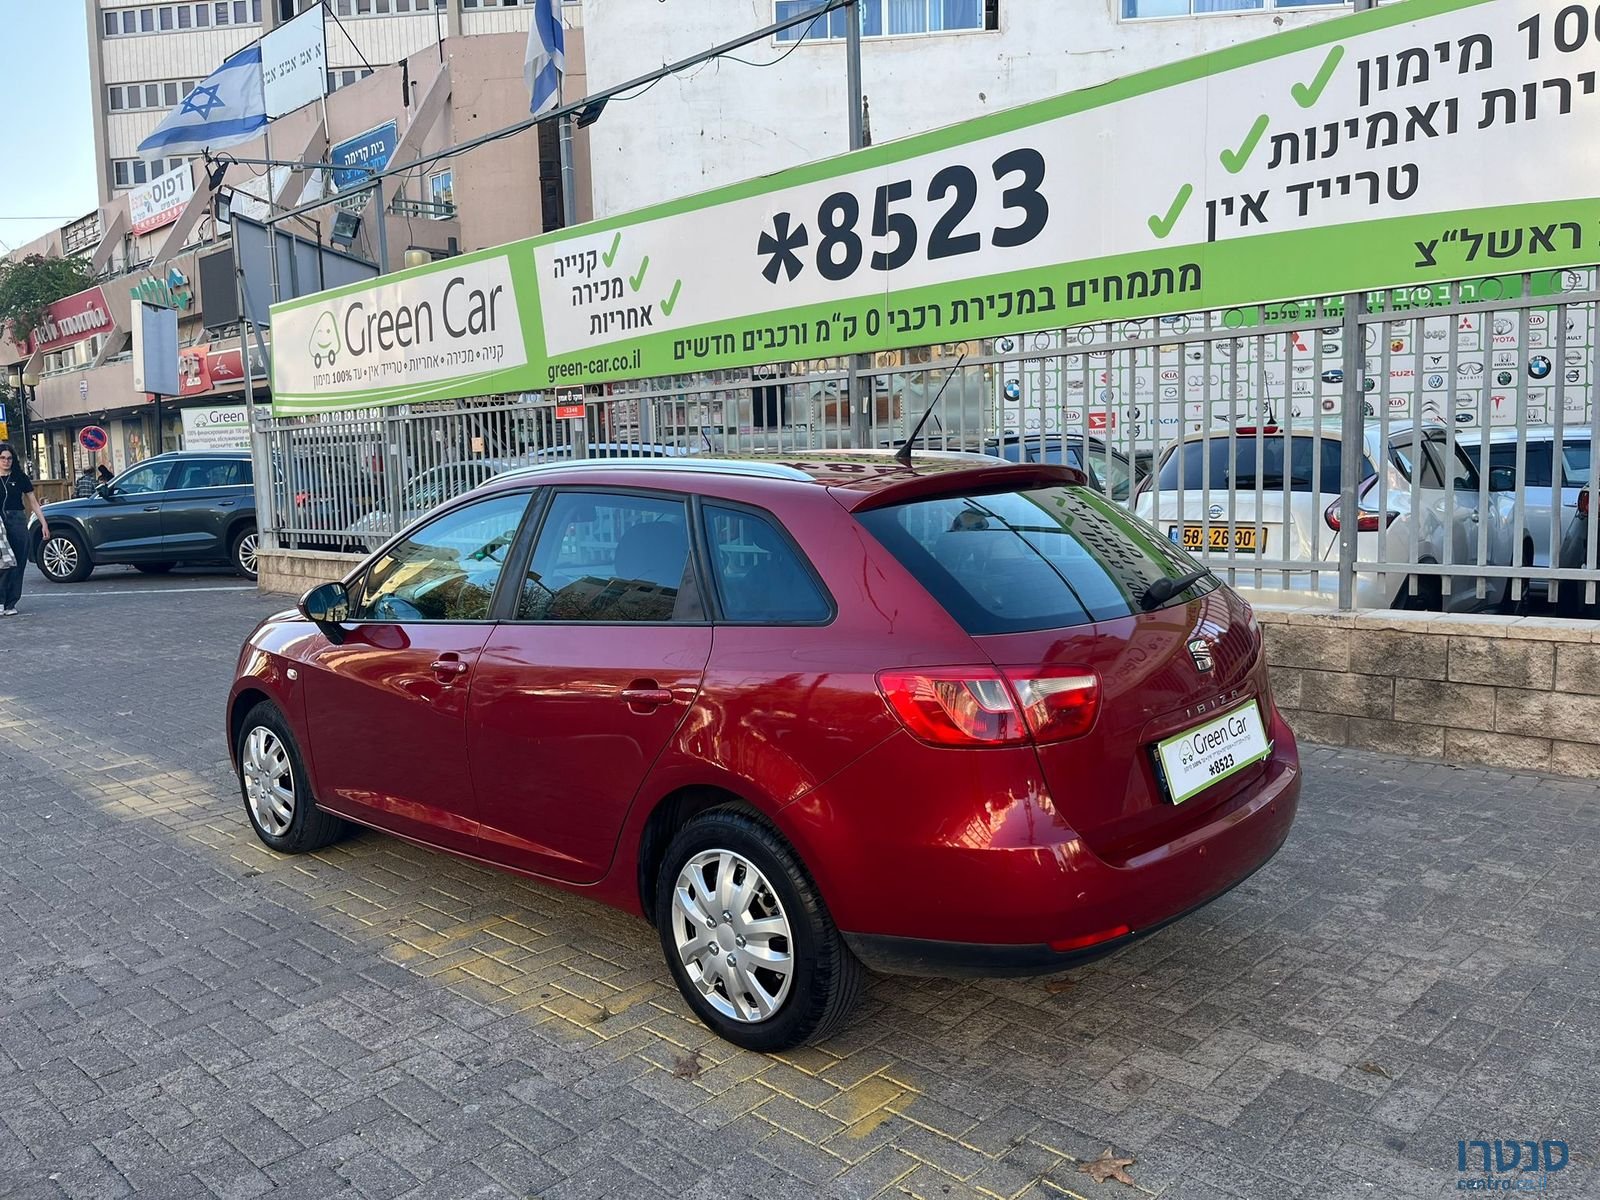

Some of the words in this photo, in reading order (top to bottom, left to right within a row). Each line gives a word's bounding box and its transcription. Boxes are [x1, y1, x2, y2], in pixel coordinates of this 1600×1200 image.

[1517, 3, 1600, 60] 10
[1356, 33, 1493, 107] מימון
[1267, 97, 1460, 170] ואמינות
[152, 172, 184, 203] דפוס
[1286, 162, 1420, 217] טרייד
[1206, 189, 1270, 242] אין
[554, 250, 598, 279] קנייה
[572, 277, 624, 307] מכירה
[1066, 262, 1202, 306] מתמחים
[345, 300, 434, 357] Green
[442, 276, 503, 339] Car
[590, 304, 653, 336] אחריות
[886, 303, 942, 334] רכבי
[949, 286, 1056, 326] במכירת
[673, 333, 736, 361] חדשים
[742, 322, 808, 352] ורכבים
[381, 361, 402, 375] טרייד
[409, 355, 439, 371] אחריות
[447, 349, 474, 366] מכירה
[482, 345, 504, 363] קניה
[548, 349, 641, 383] green-car.co.il
[313, 373, 331, 390] מימון
[332, 369, 352, 384] 100%
[368, 365, 379, 381] אין
[209, 410, 245, 424] Green
[1186, 690, 1238, 718] IBIZA
[1193, 727, 1229, 755] Green
[1228, 716, 1247, 738] Car
